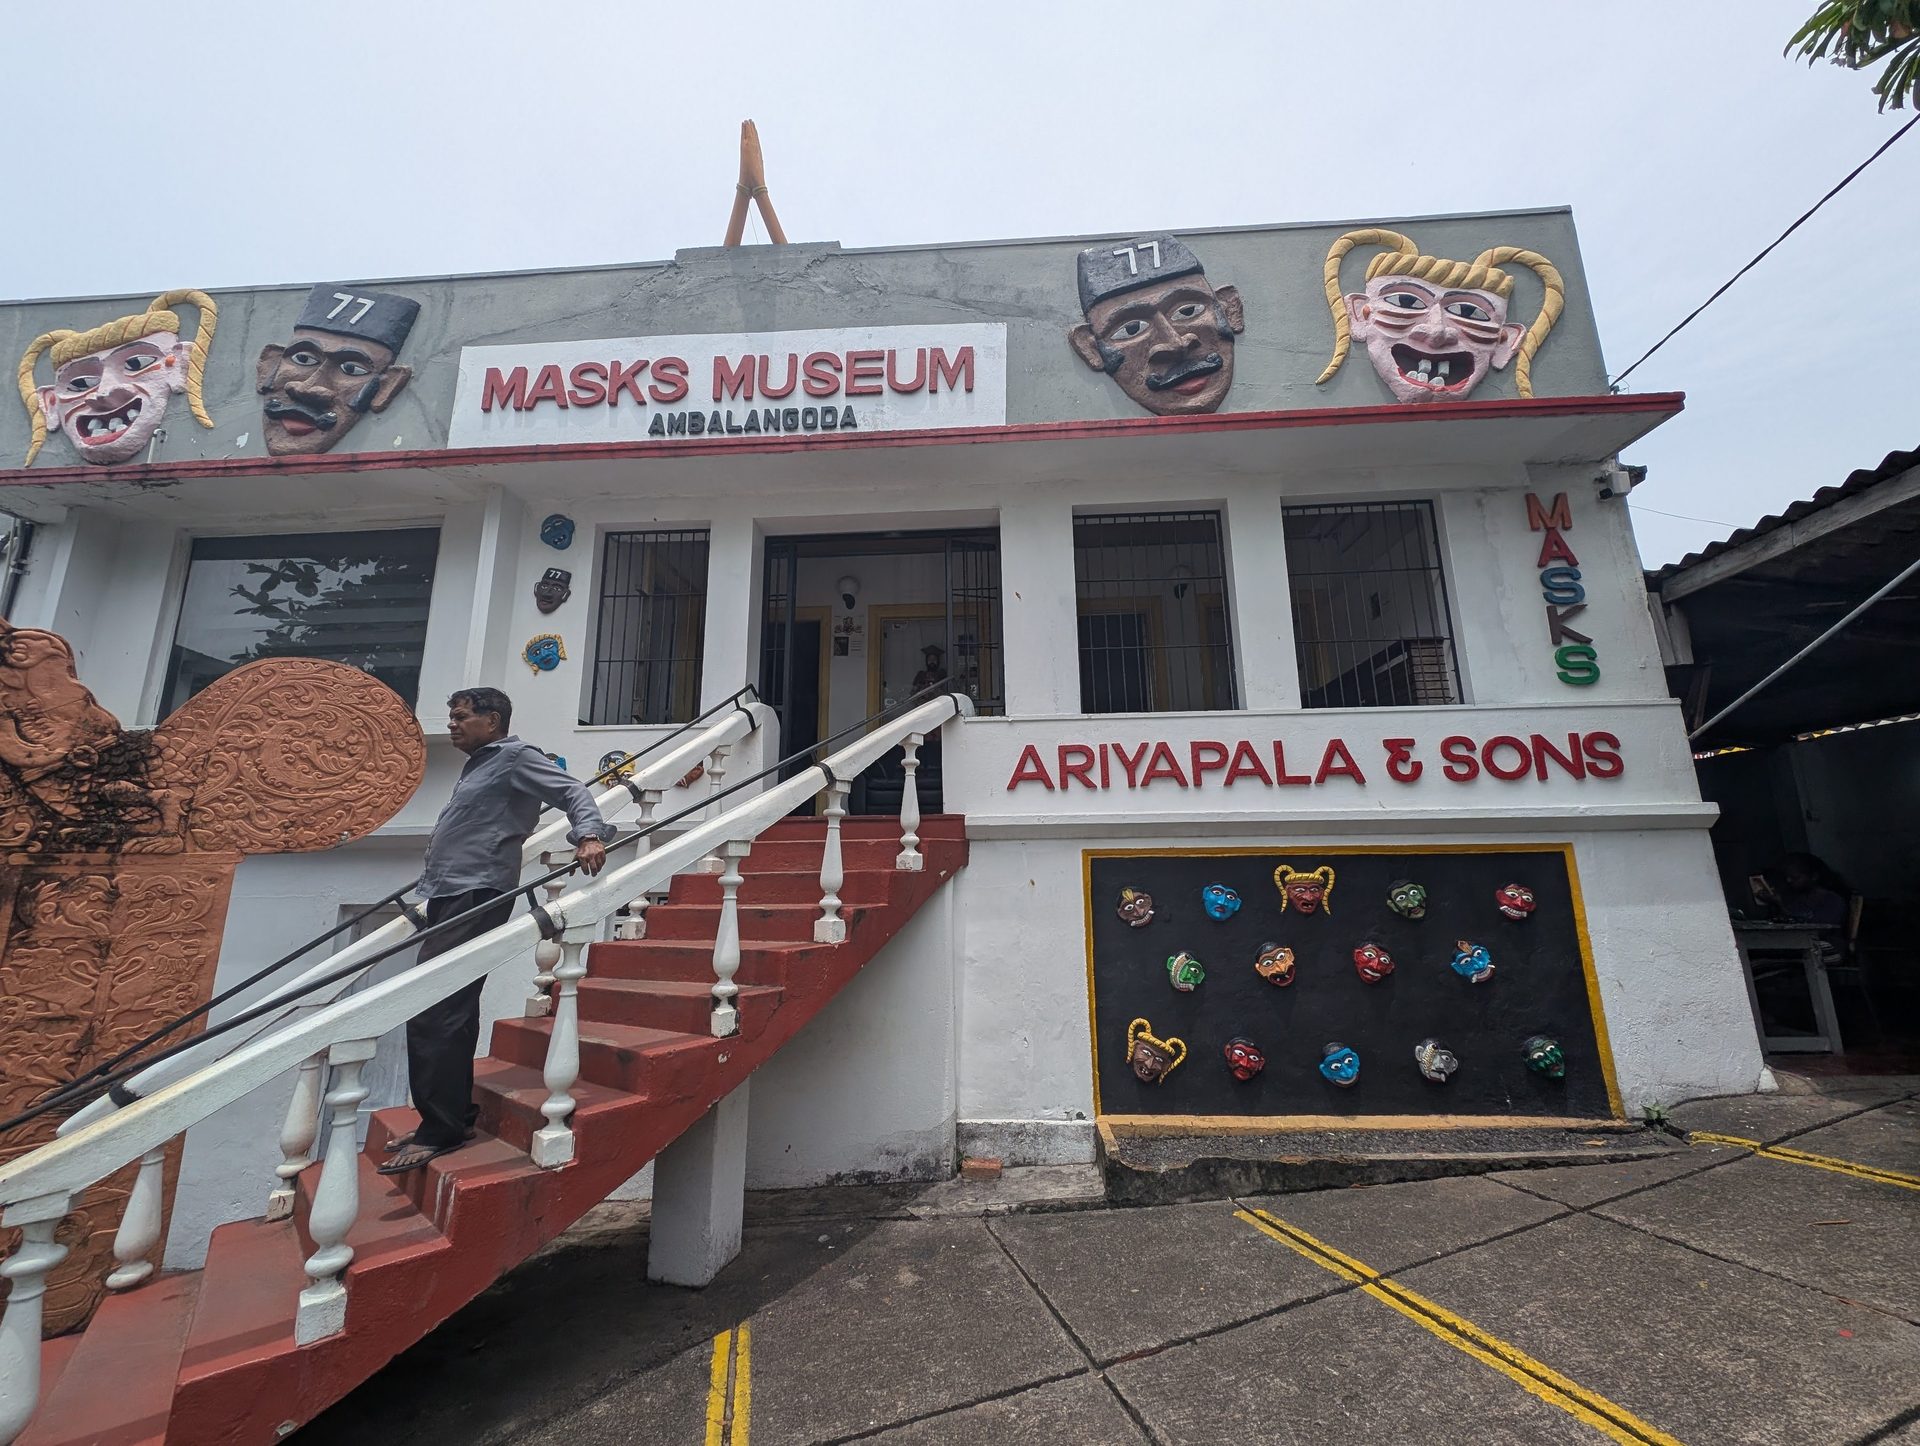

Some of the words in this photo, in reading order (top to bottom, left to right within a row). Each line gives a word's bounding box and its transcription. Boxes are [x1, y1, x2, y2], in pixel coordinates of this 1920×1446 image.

[1113, 241, 1160, 275] 77
[326, 292, 376, 325] 77
[481, 356, 689, 412] MASKS
[712, 346, 974, 402] MUSEUM
[648, 405, 857, 436] AMBALANGODA
[1524, 492, 1600, 685] MASKS
[1006, 738, 1366, 790] ARIYAPALA
[1383, 738, 1422, 782] &
[1441, 730, 1625, 783] SONS
